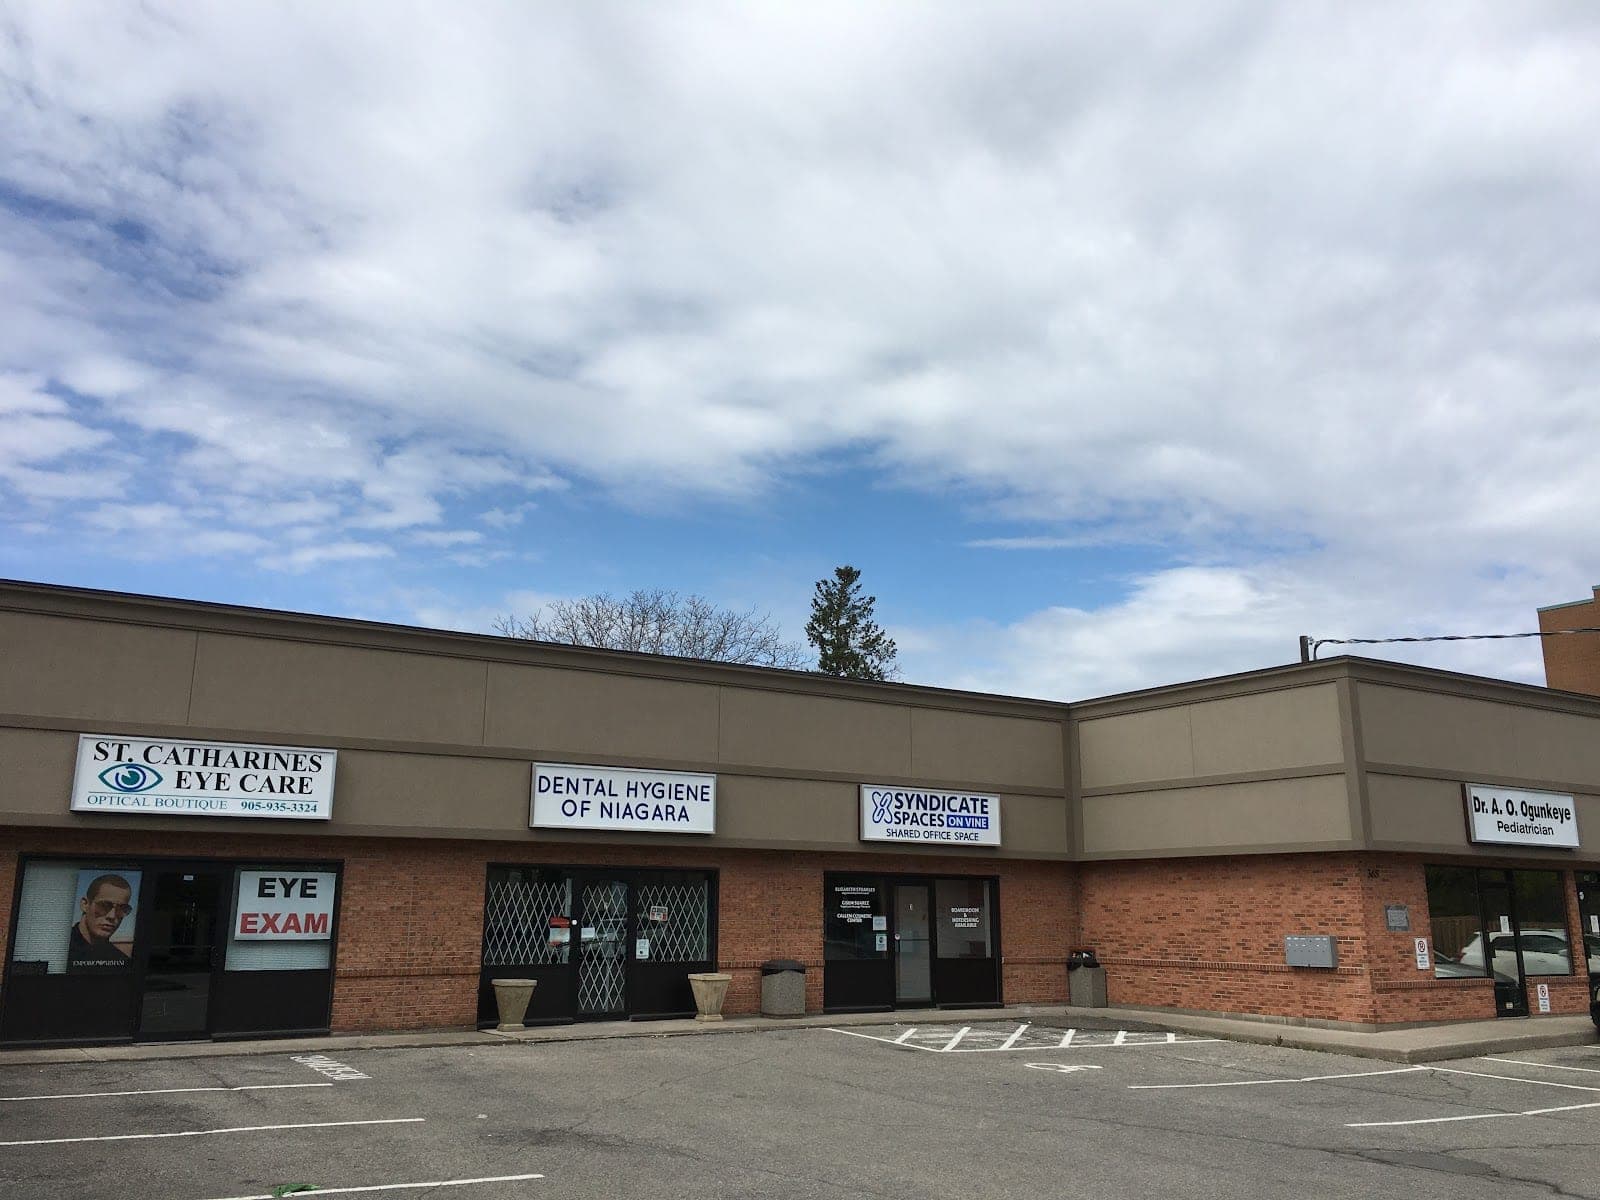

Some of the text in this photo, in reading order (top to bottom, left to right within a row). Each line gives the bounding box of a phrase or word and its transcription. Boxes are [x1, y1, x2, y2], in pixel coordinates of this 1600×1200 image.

[93, 741, 323, 773] ST. CATHARINES
[175, 770, 314, 795] EYE CARE
[538, 775, 711, 802] DENTAL HYGIENE
[87, 794, 318, 813] OPTICAL BOUTIQUE 905-935-3324
[561, 799, 690, 822] OF NIAGARA
[894, 792, 989, 815] SYNDICATE
[1473, 796, 1571, 824] Dr. A. O. Ogunkeye
[894, 811, 987, 829] SPACES ON VINE
[1497, 820, 1554, 835] Pediatrician
[886, 828, 979, 841] SHARED OFFICE SPACE
[257, 877, 318, 899] EYE
[239, 912, 328, 934] EXAM
